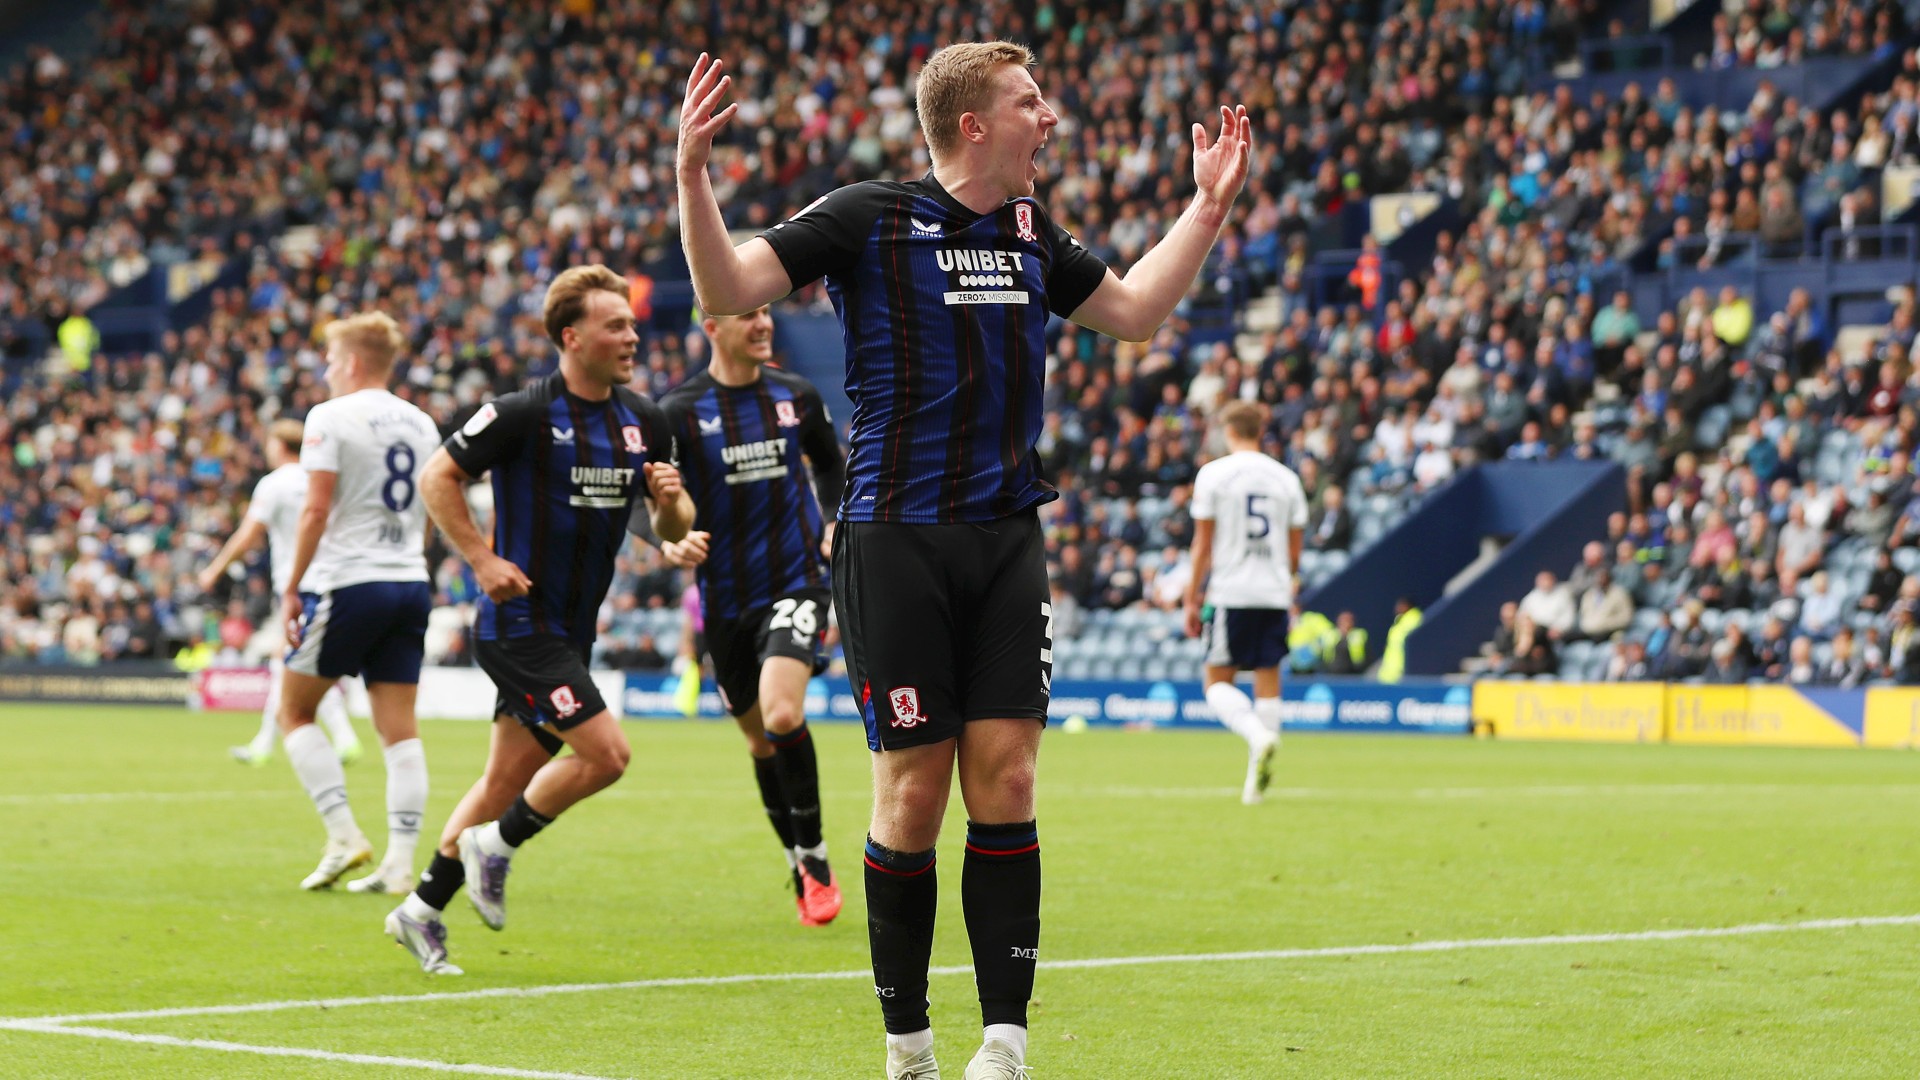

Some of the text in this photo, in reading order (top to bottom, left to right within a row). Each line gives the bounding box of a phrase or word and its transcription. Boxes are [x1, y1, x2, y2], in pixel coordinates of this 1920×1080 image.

[936, 250, 1023, 272] UNIBET
[988, 293, 1020, 302] MISSION
[721, 438, 788, 465] UNIBET
[382, 441, 415, 512] 8
[570, 466, 635, 485] UNIBET
[1246, 493, 1270, 539] 5
[769, 598, 817, 635] 26
[1011, 946, 1038, 960] MF
[874, 985, 896, 998] FC
